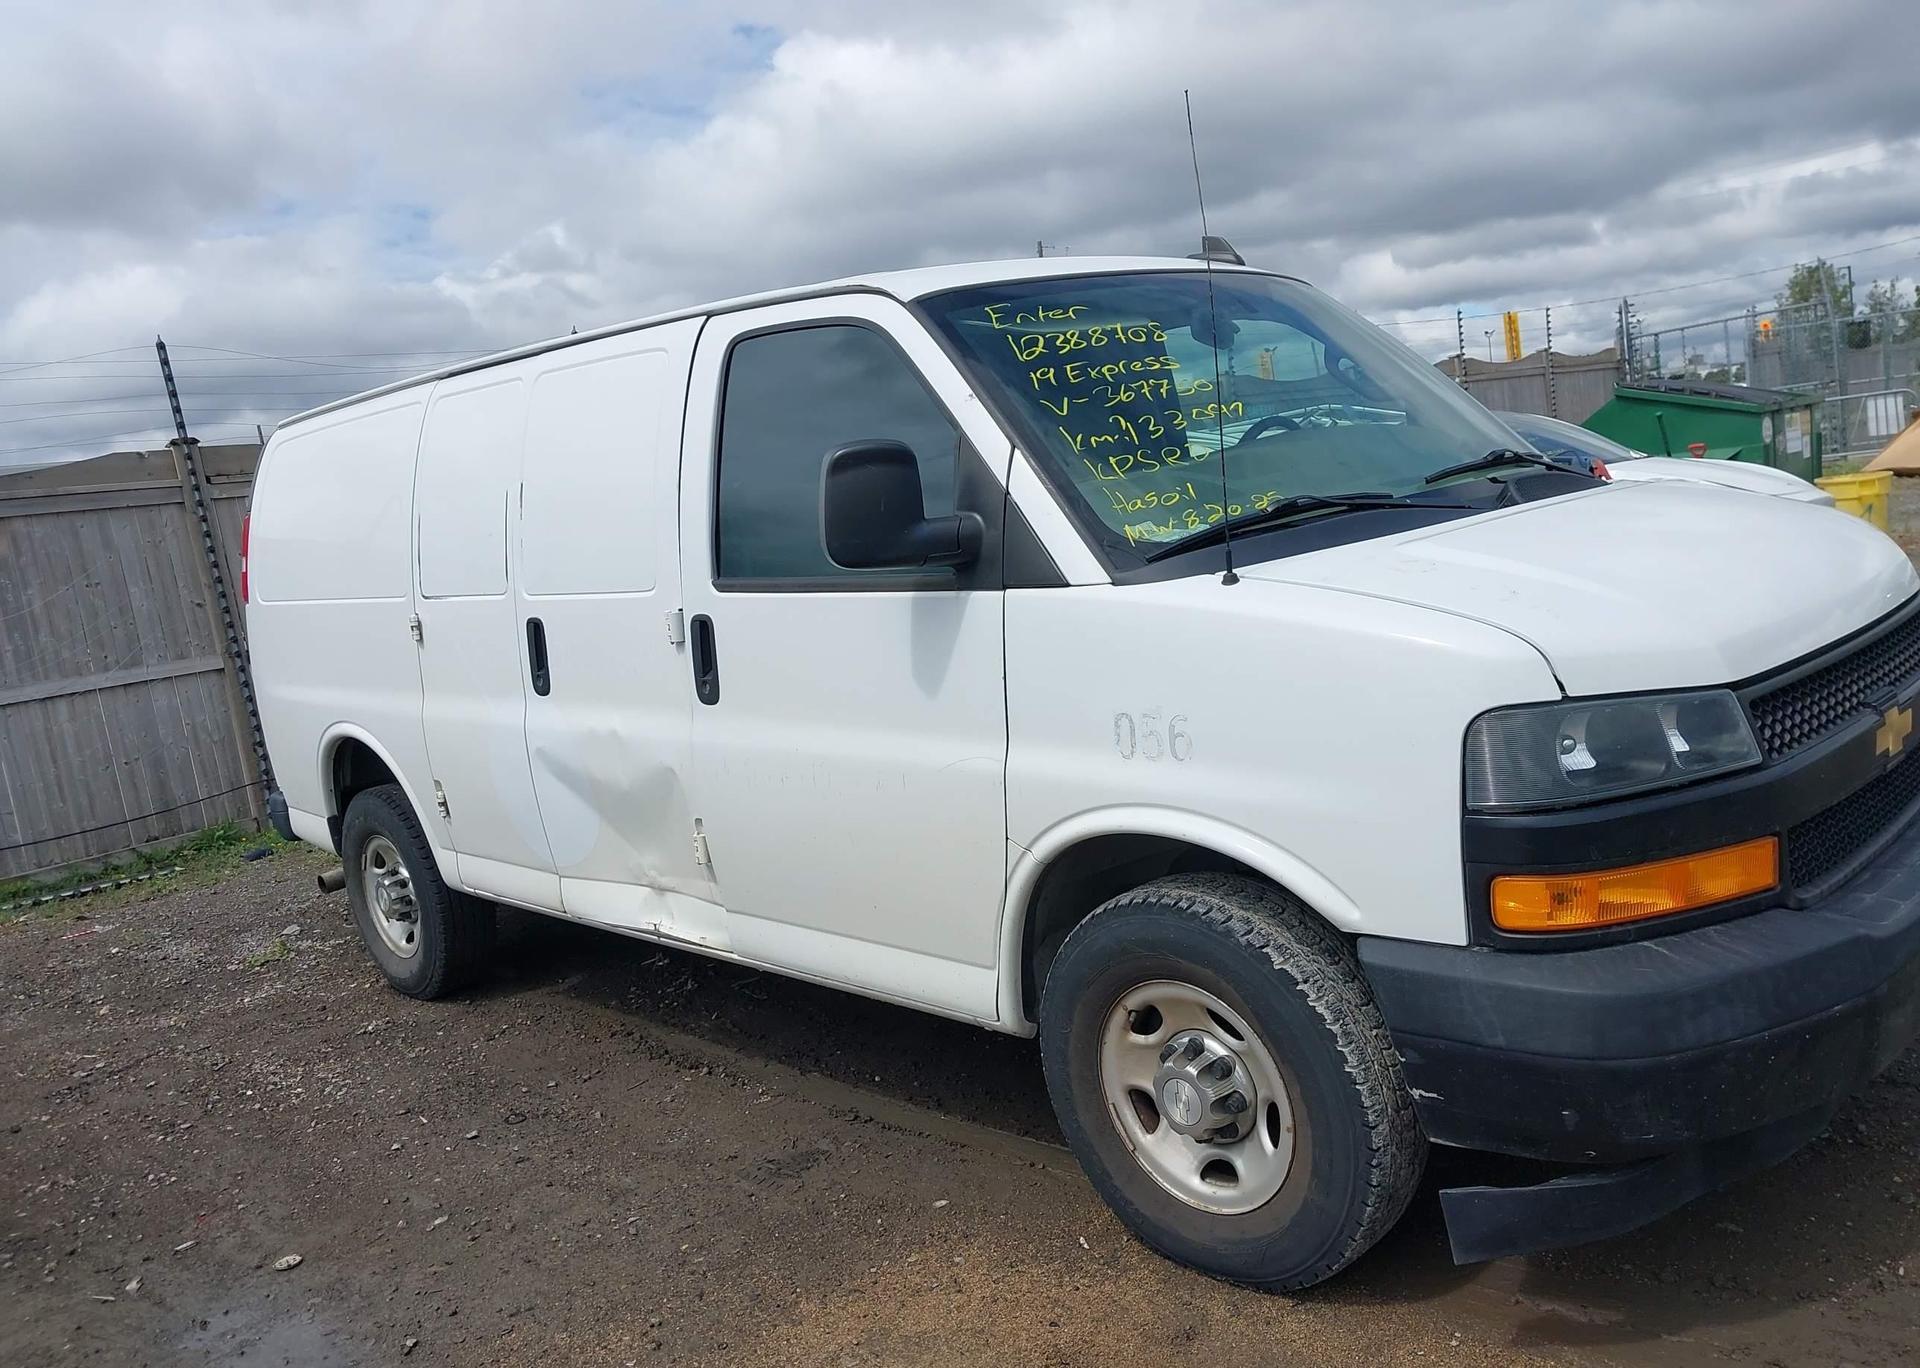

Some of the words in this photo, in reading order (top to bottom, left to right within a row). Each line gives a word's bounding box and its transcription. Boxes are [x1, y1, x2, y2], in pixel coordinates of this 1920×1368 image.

[984, 303, 1089, 329] Enter
[1006, 321, 1168, 362] 12388708
[1028, 366, 1057, 391] 19
[1063, 355, 1181, 384] Express
[1113, 711, 1193, 762] 056
